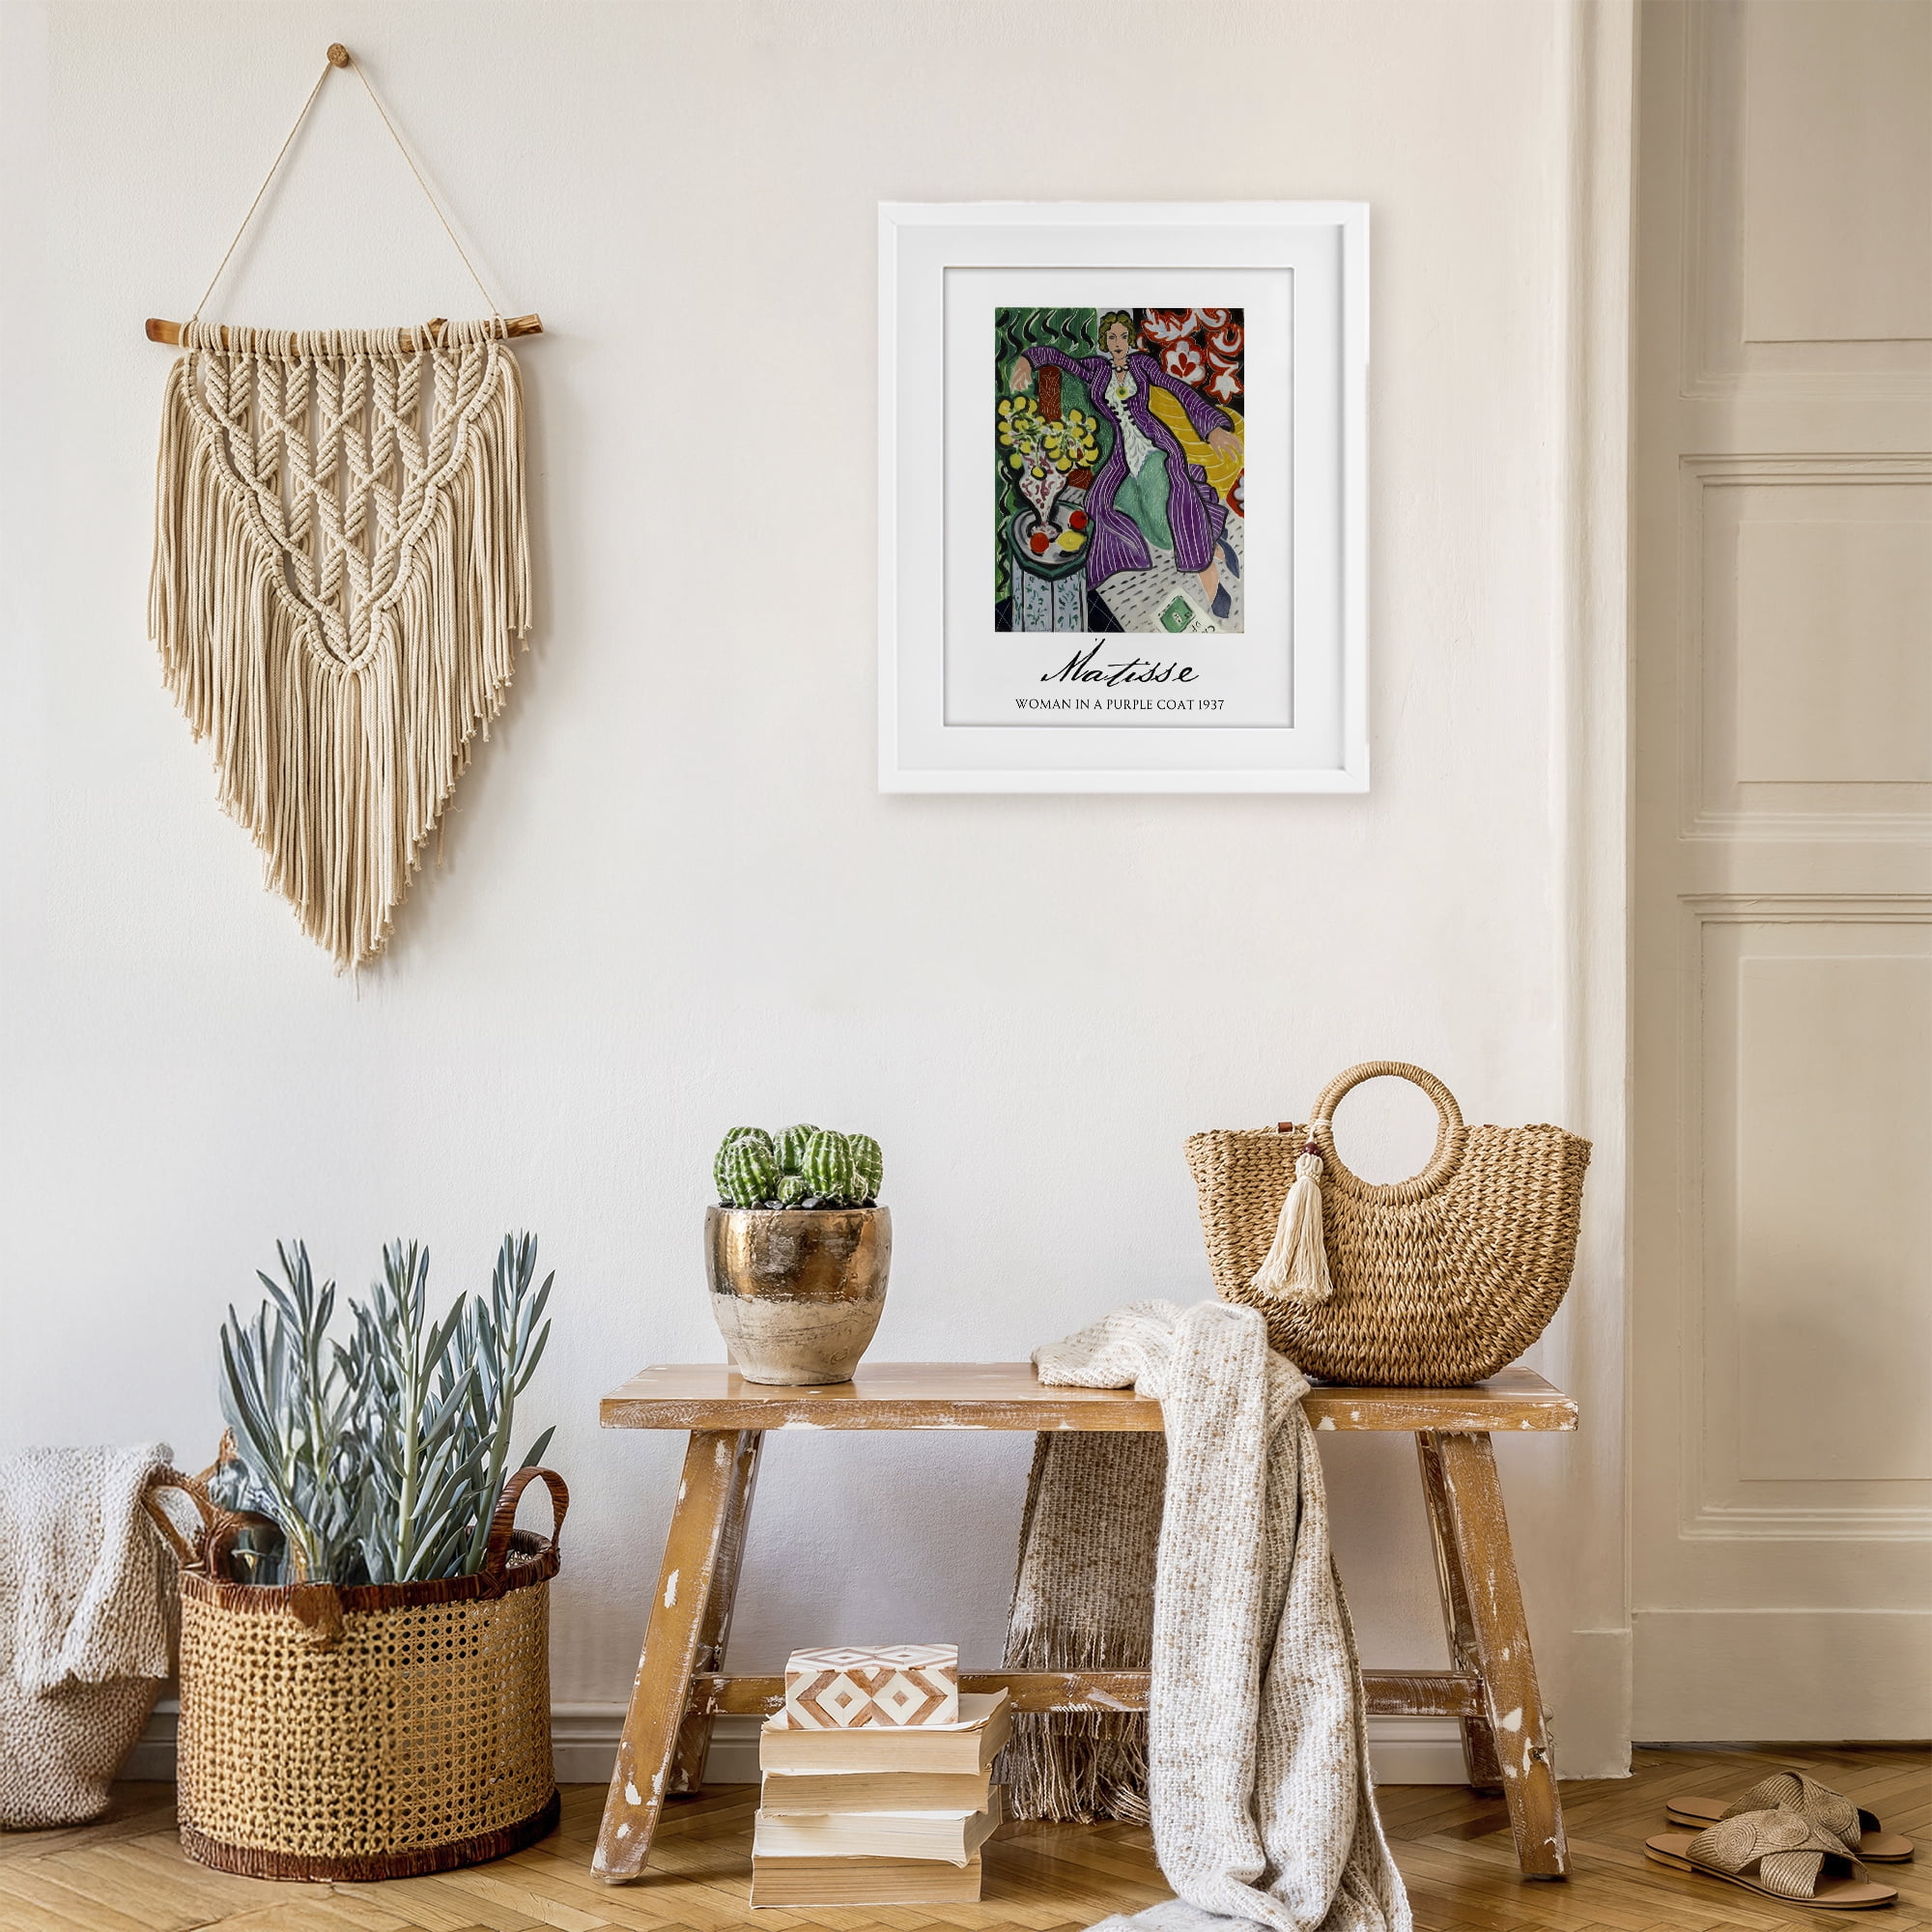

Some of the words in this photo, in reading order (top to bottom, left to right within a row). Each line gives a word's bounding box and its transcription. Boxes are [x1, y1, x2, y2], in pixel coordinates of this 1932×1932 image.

[1040, 638, 1199, 687] Matisse
[1015, 698, 1071, 710] WOMAN
[1075, 698, 1090, 710] IN
[1094, 698, 1102, 710] A
[1107, 698, 1152, 710] PURPLE
[1156, 698, 1194, 710] COAT
[1198, 698, 1225, 710] 1937
